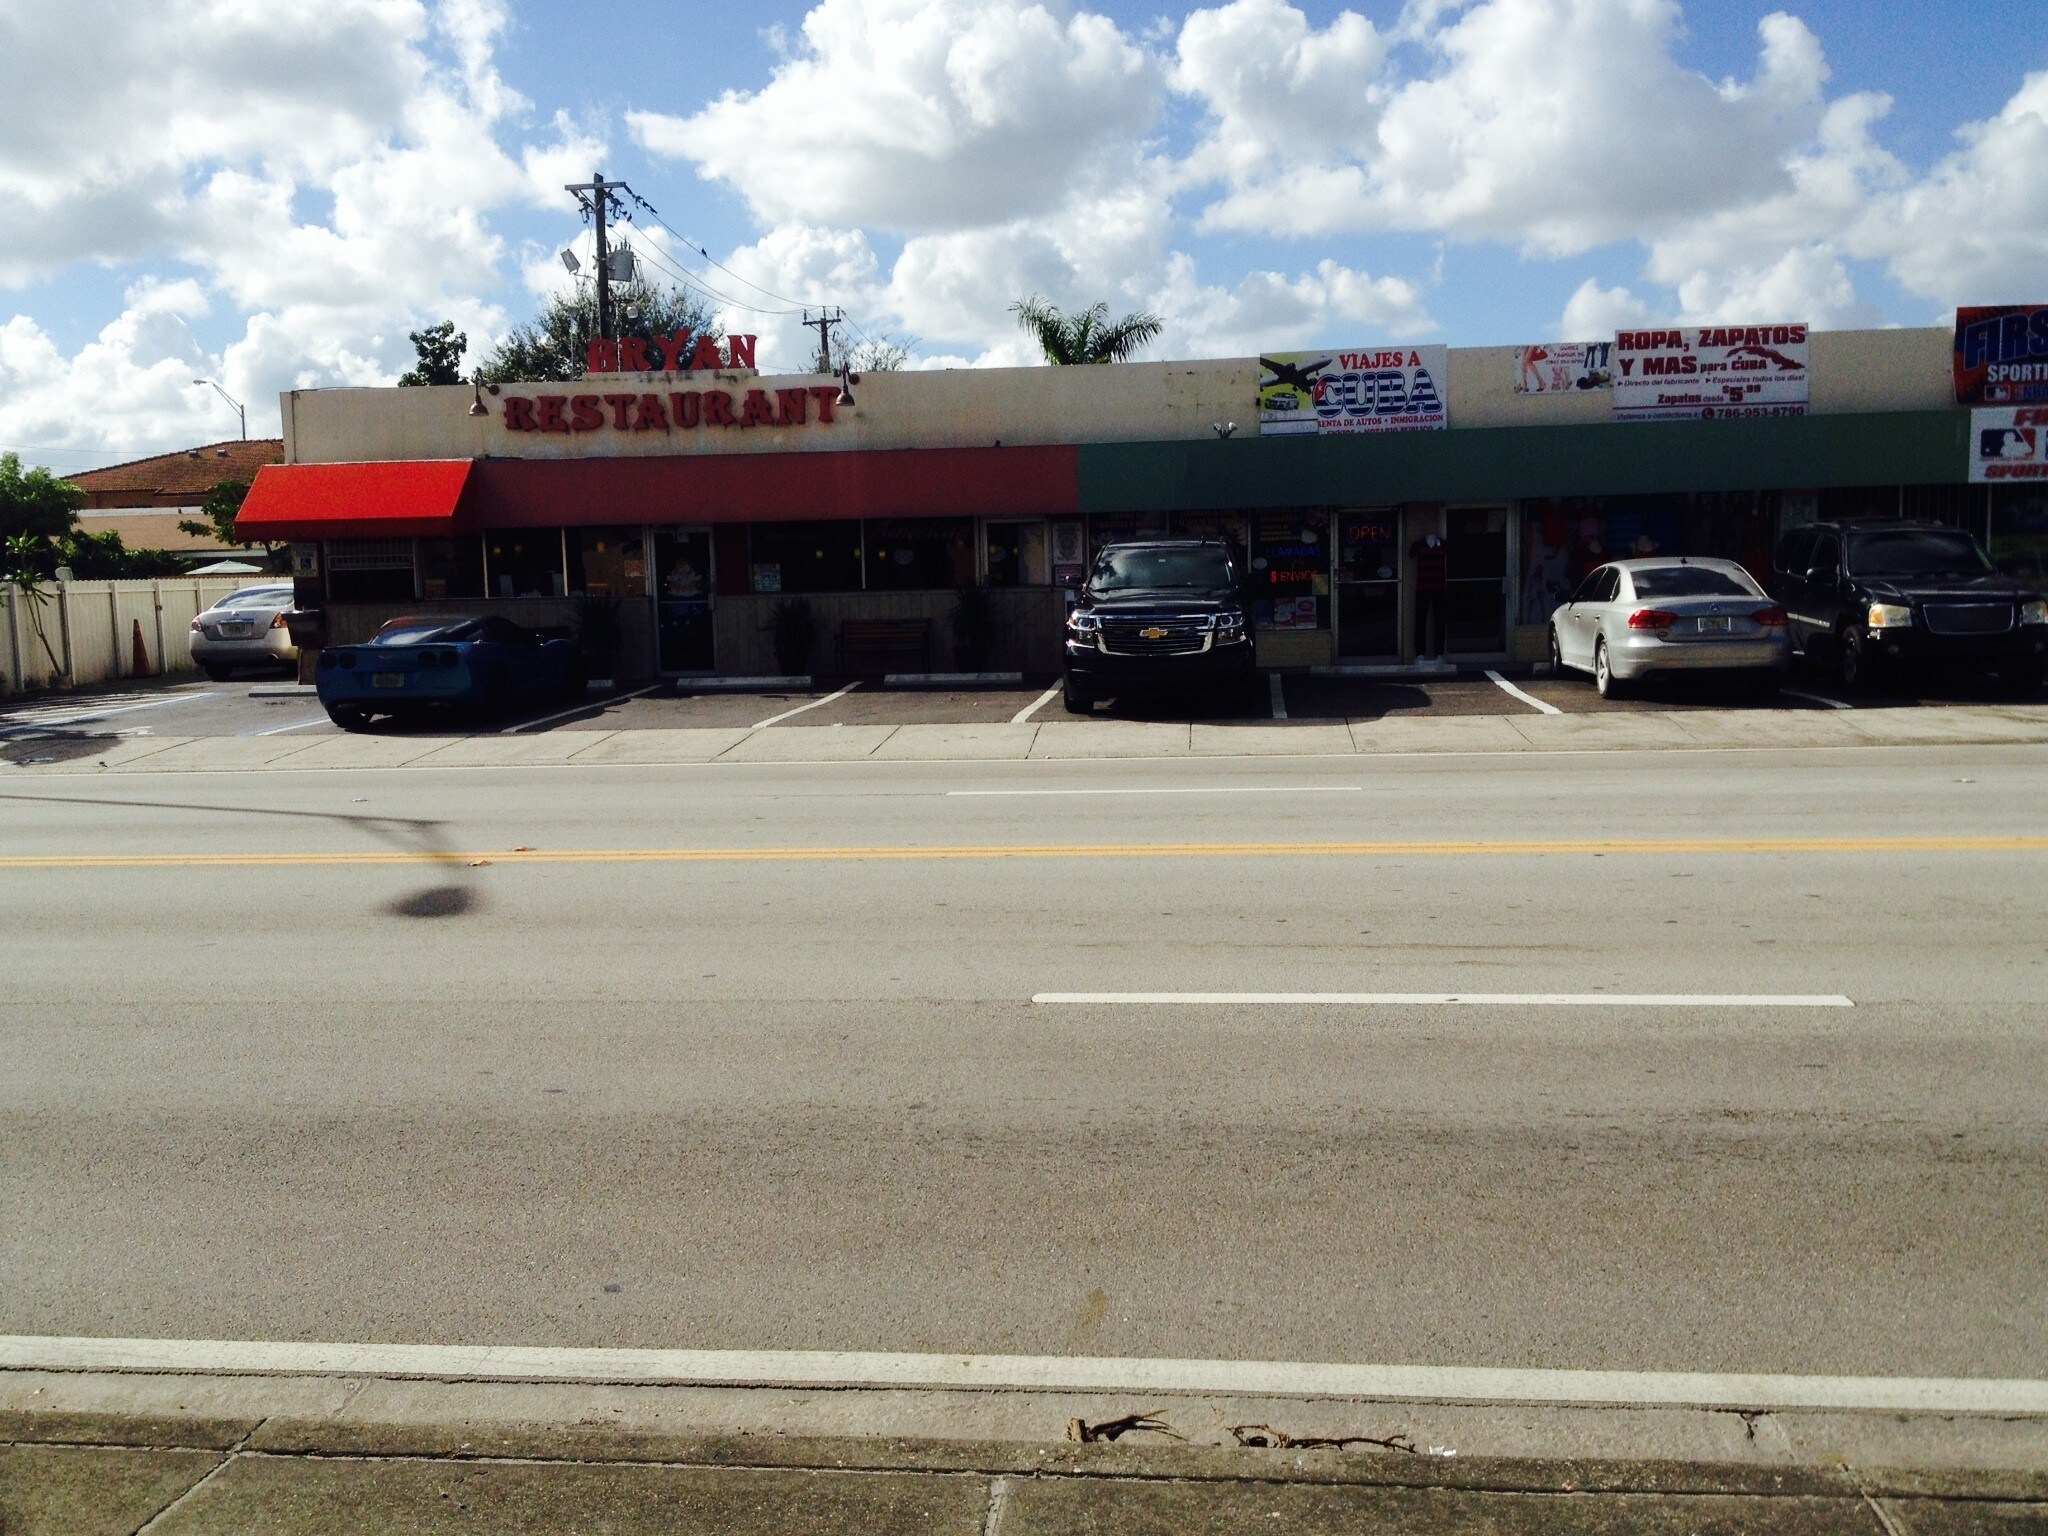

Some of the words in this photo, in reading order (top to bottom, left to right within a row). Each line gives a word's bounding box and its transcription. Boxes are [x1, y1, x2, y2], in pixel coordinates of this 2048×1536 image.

[1618, 331, 1690, 352] ROPA,
[1698, 326, 1806, 347] ZAPATOS
[587, 328, 758, 373] BRYAN
[1339, 352, 1404, 370] VIAJES
[1407, 351, 1421, 366] A
[1619, 358, 1635, 376] Y
[1643, 356, 1697, 375] MAS
[1700, 362, 1728, 373] para
[1731, 359, 1767, 371] CUBA
[1624, 378, 1649, 387] Directo
[1713, 376, 1750, 385] Especiales
[1312, 368, 1442, 417] CUBA
[1658, 394, 1701, 405] Zapatos
[504, 386, 842, 432] RESTAURANT
[1716, 406, 1804, 418] 786-953-8790
[1344, 418, 1355, 426] DE
[1356, 417, 1382, 426] AUTOS
[1348, 525, 1391, 541] OPEN
[1265, 545, 1322, 558] LLAMADAS
